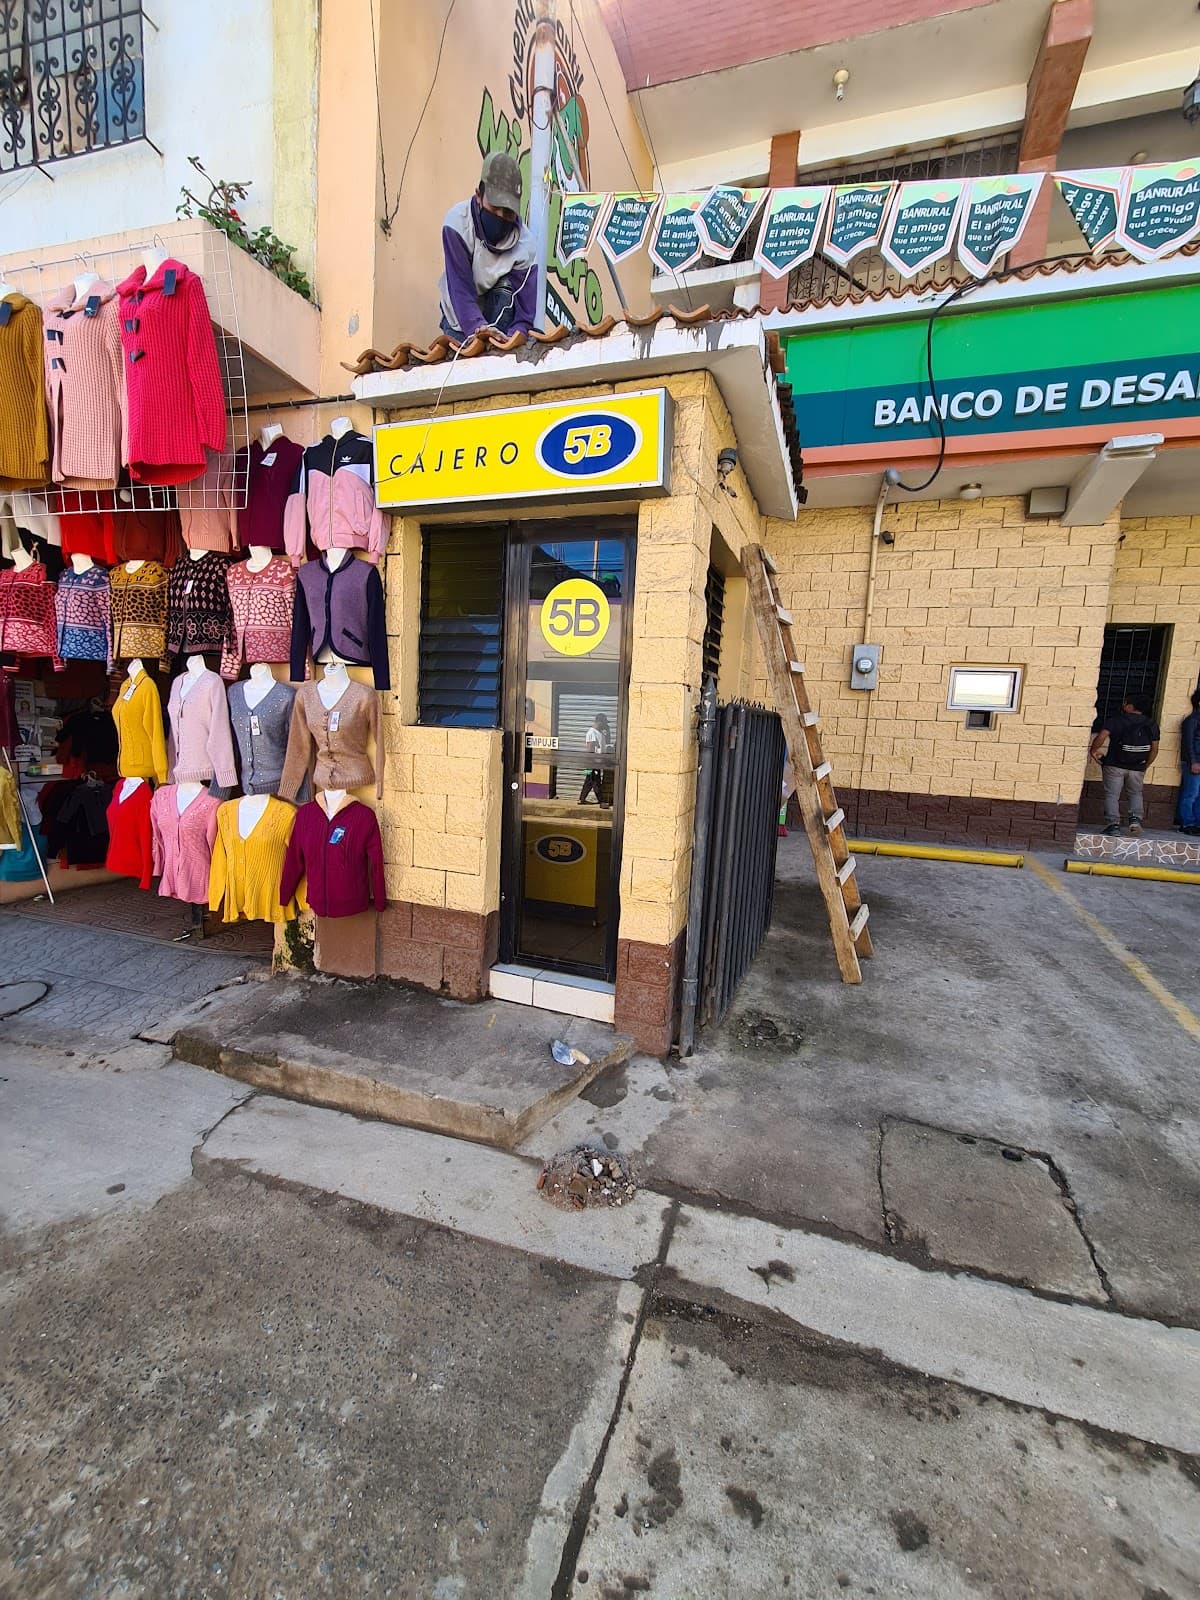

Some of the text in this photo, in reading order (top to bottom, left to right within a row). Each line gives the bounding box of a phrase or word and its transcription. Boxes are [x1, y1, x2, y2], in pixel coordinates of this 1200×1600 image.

[1136, 181, 1200, 203] BANRURAL
[716, 192, 749, 218] BANRURAL
[838, 194, 884, 207] BANRURAL
[974, 198, 1024, 216] BANRURAL
[1088, 194, 1105, 220] ayuda
[710, 198, 741, 233] El amigo
[836, 208, 878, 224] El amigo
[902, 206, 952, 220] BANRURAL
[1132, 202, 1195, 218] El amigo
[612, 215, 642, 229] El amigo
[772, 212, 816, 224] BANRURAL
[970, 213, 1017, 230] El amigo
[1092, 206, 1110, 235] crecer
[1128, 215, 1194, 230] que te ayuda
[662, 229, 698, 240] El amigo
[769, 226, 810, 238] El amigo
[833, 226, 845, 235] que
[854, 220, 877, 229] ayuda
[898, 222, 946, 234] El amigo
[1147, 226, 1178, 236] crecer
[788, 238, 808, 246] ayuda
[844, 230, 866, 240] crecer
[894, 234, 944, 245] que te ayuda
[967, 234, 982, 242] que
[984, 233, 992, 241] te
[777, 249, 798, 257] crecer
[906, 245, 932, 254] crecer
[874, 370, 1200, 427] BANCO DE DESA
[389, 424, 612, 476] CAJERO 5B
[548, 598, 601, 637] 5B
[526, 736, 558, 749] EMPUJE
[547, 839, 573, 859] 5B
